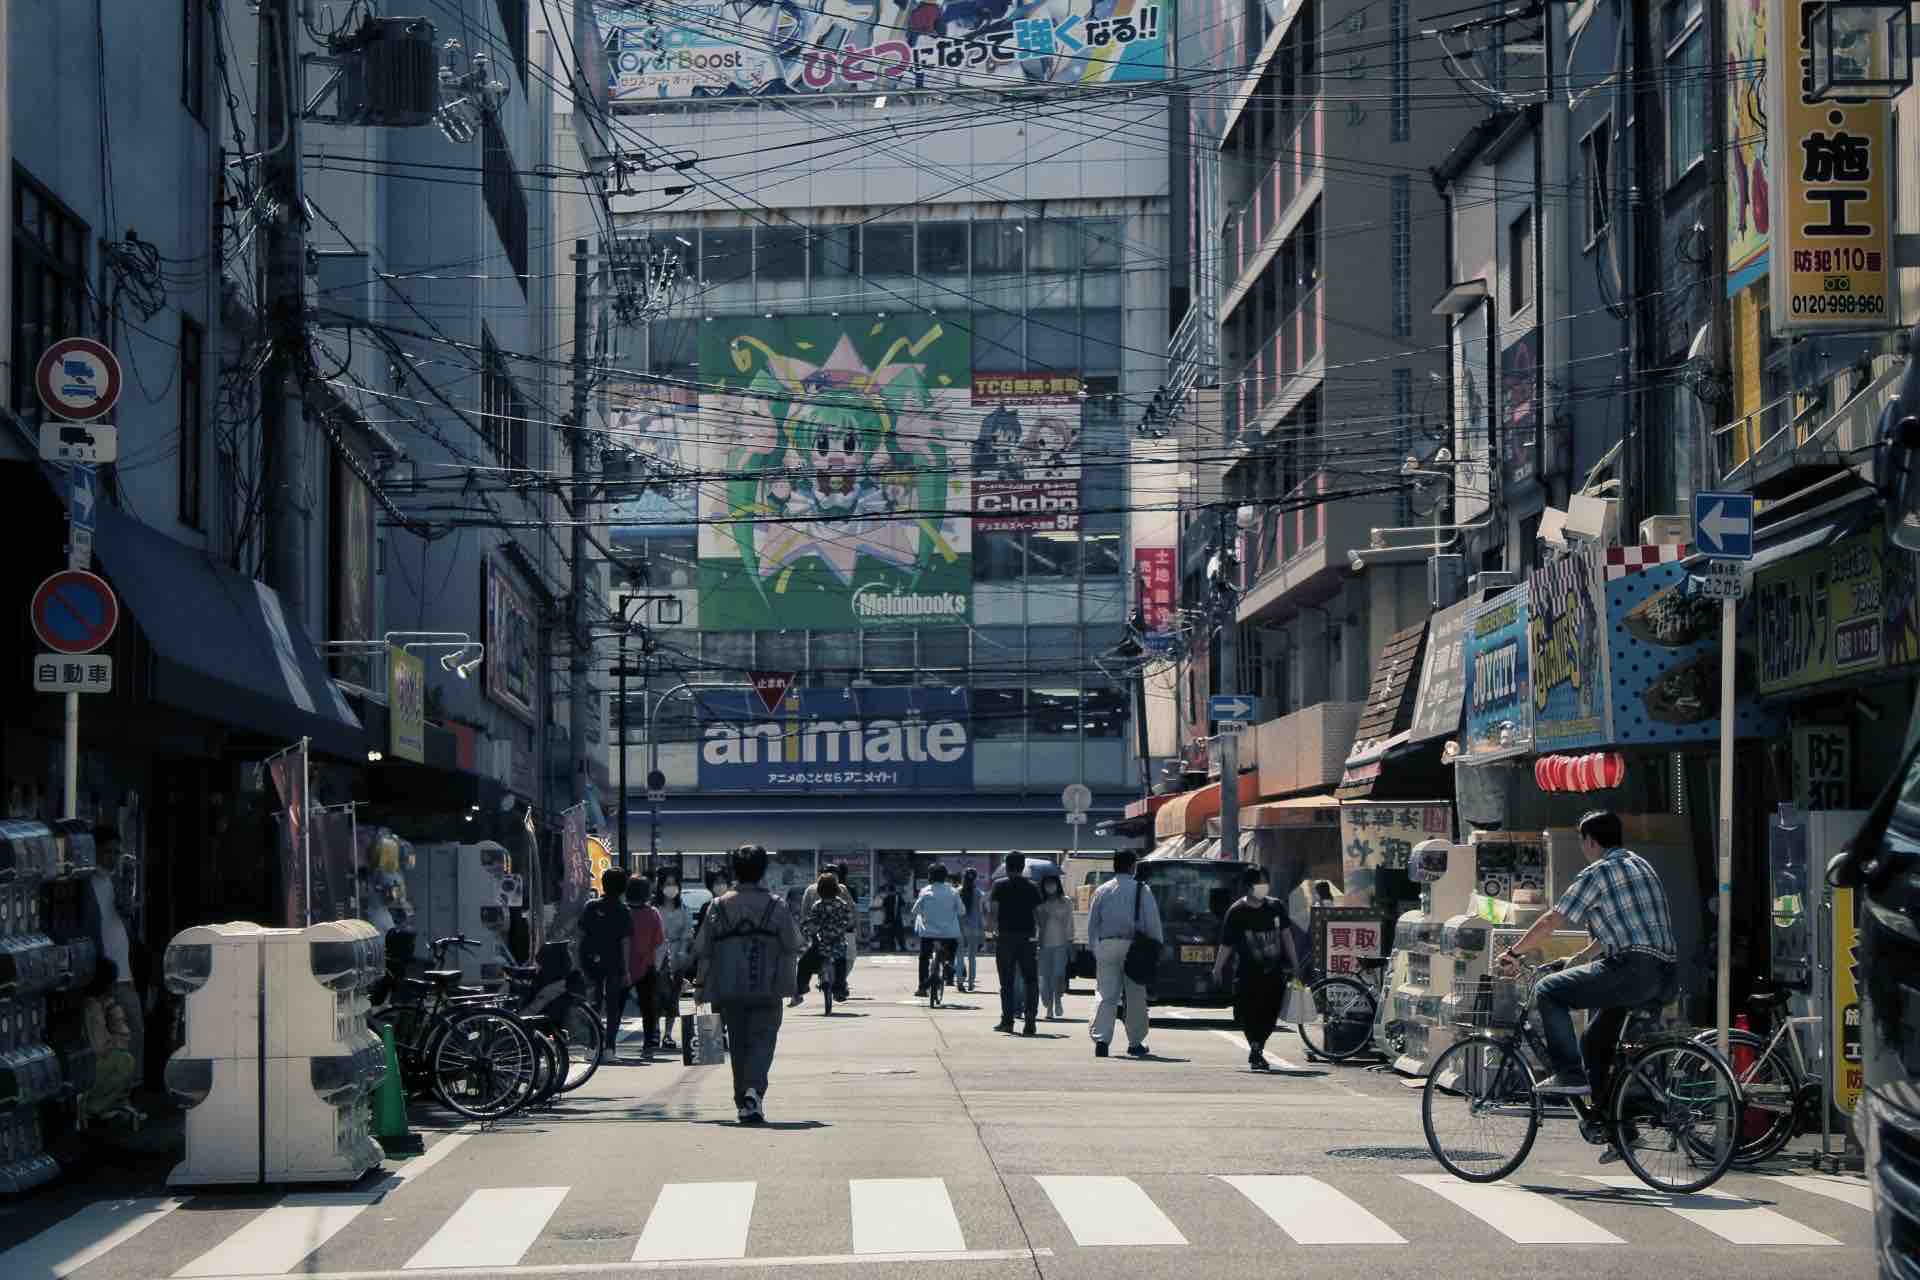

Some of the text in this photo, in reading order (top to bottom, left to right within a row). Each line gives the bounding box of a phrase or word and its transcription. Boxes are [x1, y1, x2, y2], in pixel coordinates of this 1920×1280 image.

[1792, 295, 1885, 314] 0120-998-960
[1056, 514, 1080, 530] 5F
[1703, 578, 1743, 597] ここから
[859, 592, 967, 617] Melonbooks
[39, 663, 108, 684] 自動車
[756, 677, 787, 690] 止まれ
[702, 697, 968, 766] animate
[1330, 927, 1376, 949] 買取
